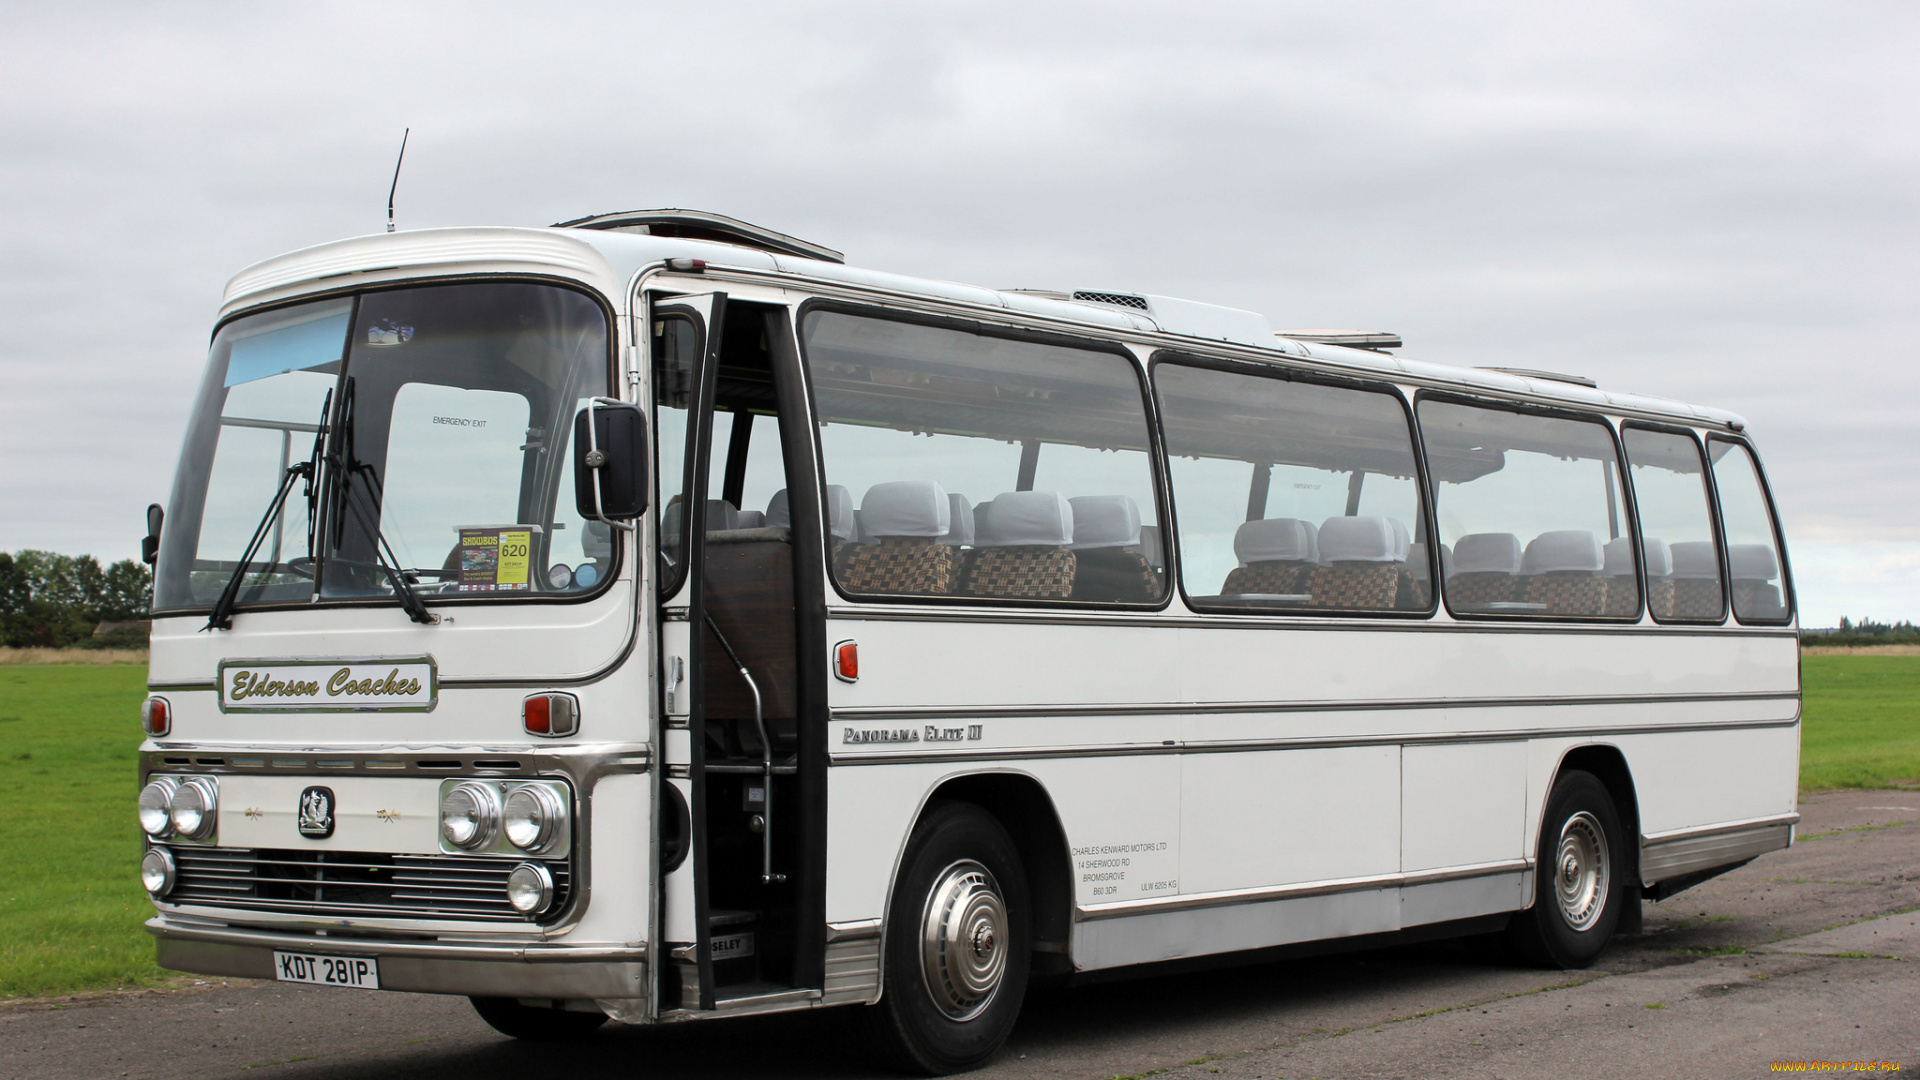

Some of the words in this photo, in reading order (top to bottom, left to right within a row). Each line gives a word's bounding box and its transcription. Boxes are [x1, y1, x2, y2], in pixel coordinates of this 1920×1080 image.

[433, 416, 471, 426] EMERGENCY
[472, 419, 487, 428] EXIT
[462, 536, 498, 546] SHOWBUS
[502, 544, 527, 557] 620
[230, 670, 320, 701] Elderson
[325, 667, 422, 696] Coaches
[1072, 846, 1100, 857] CHARLES
[1100, 844, 1130, 855] KENWARD
[1130, 843, 1156, 853] MOTORS
[1156, 842, 1167, 851] LTD
[1078, 861, 1085, 869] 14
[1085, 859, 1121, 869] SHERWOOD
[1121, 858, 1130, 867] RD
[1083, 872, 1125, 882] BROMSGROVE
[1093, 887, 1104, 895] B60
[1105, 886, 1117, 895] 3DR
[1141, 882, 1154, 891] ULW
[1155, 881, 1167, 890] 6205
[1168, 880, 1177, 889] KG
[711, 939, 741, 951] SELEY
[281, 954, 316, 981] KDT
[322, 958, 368, 985] 281P
